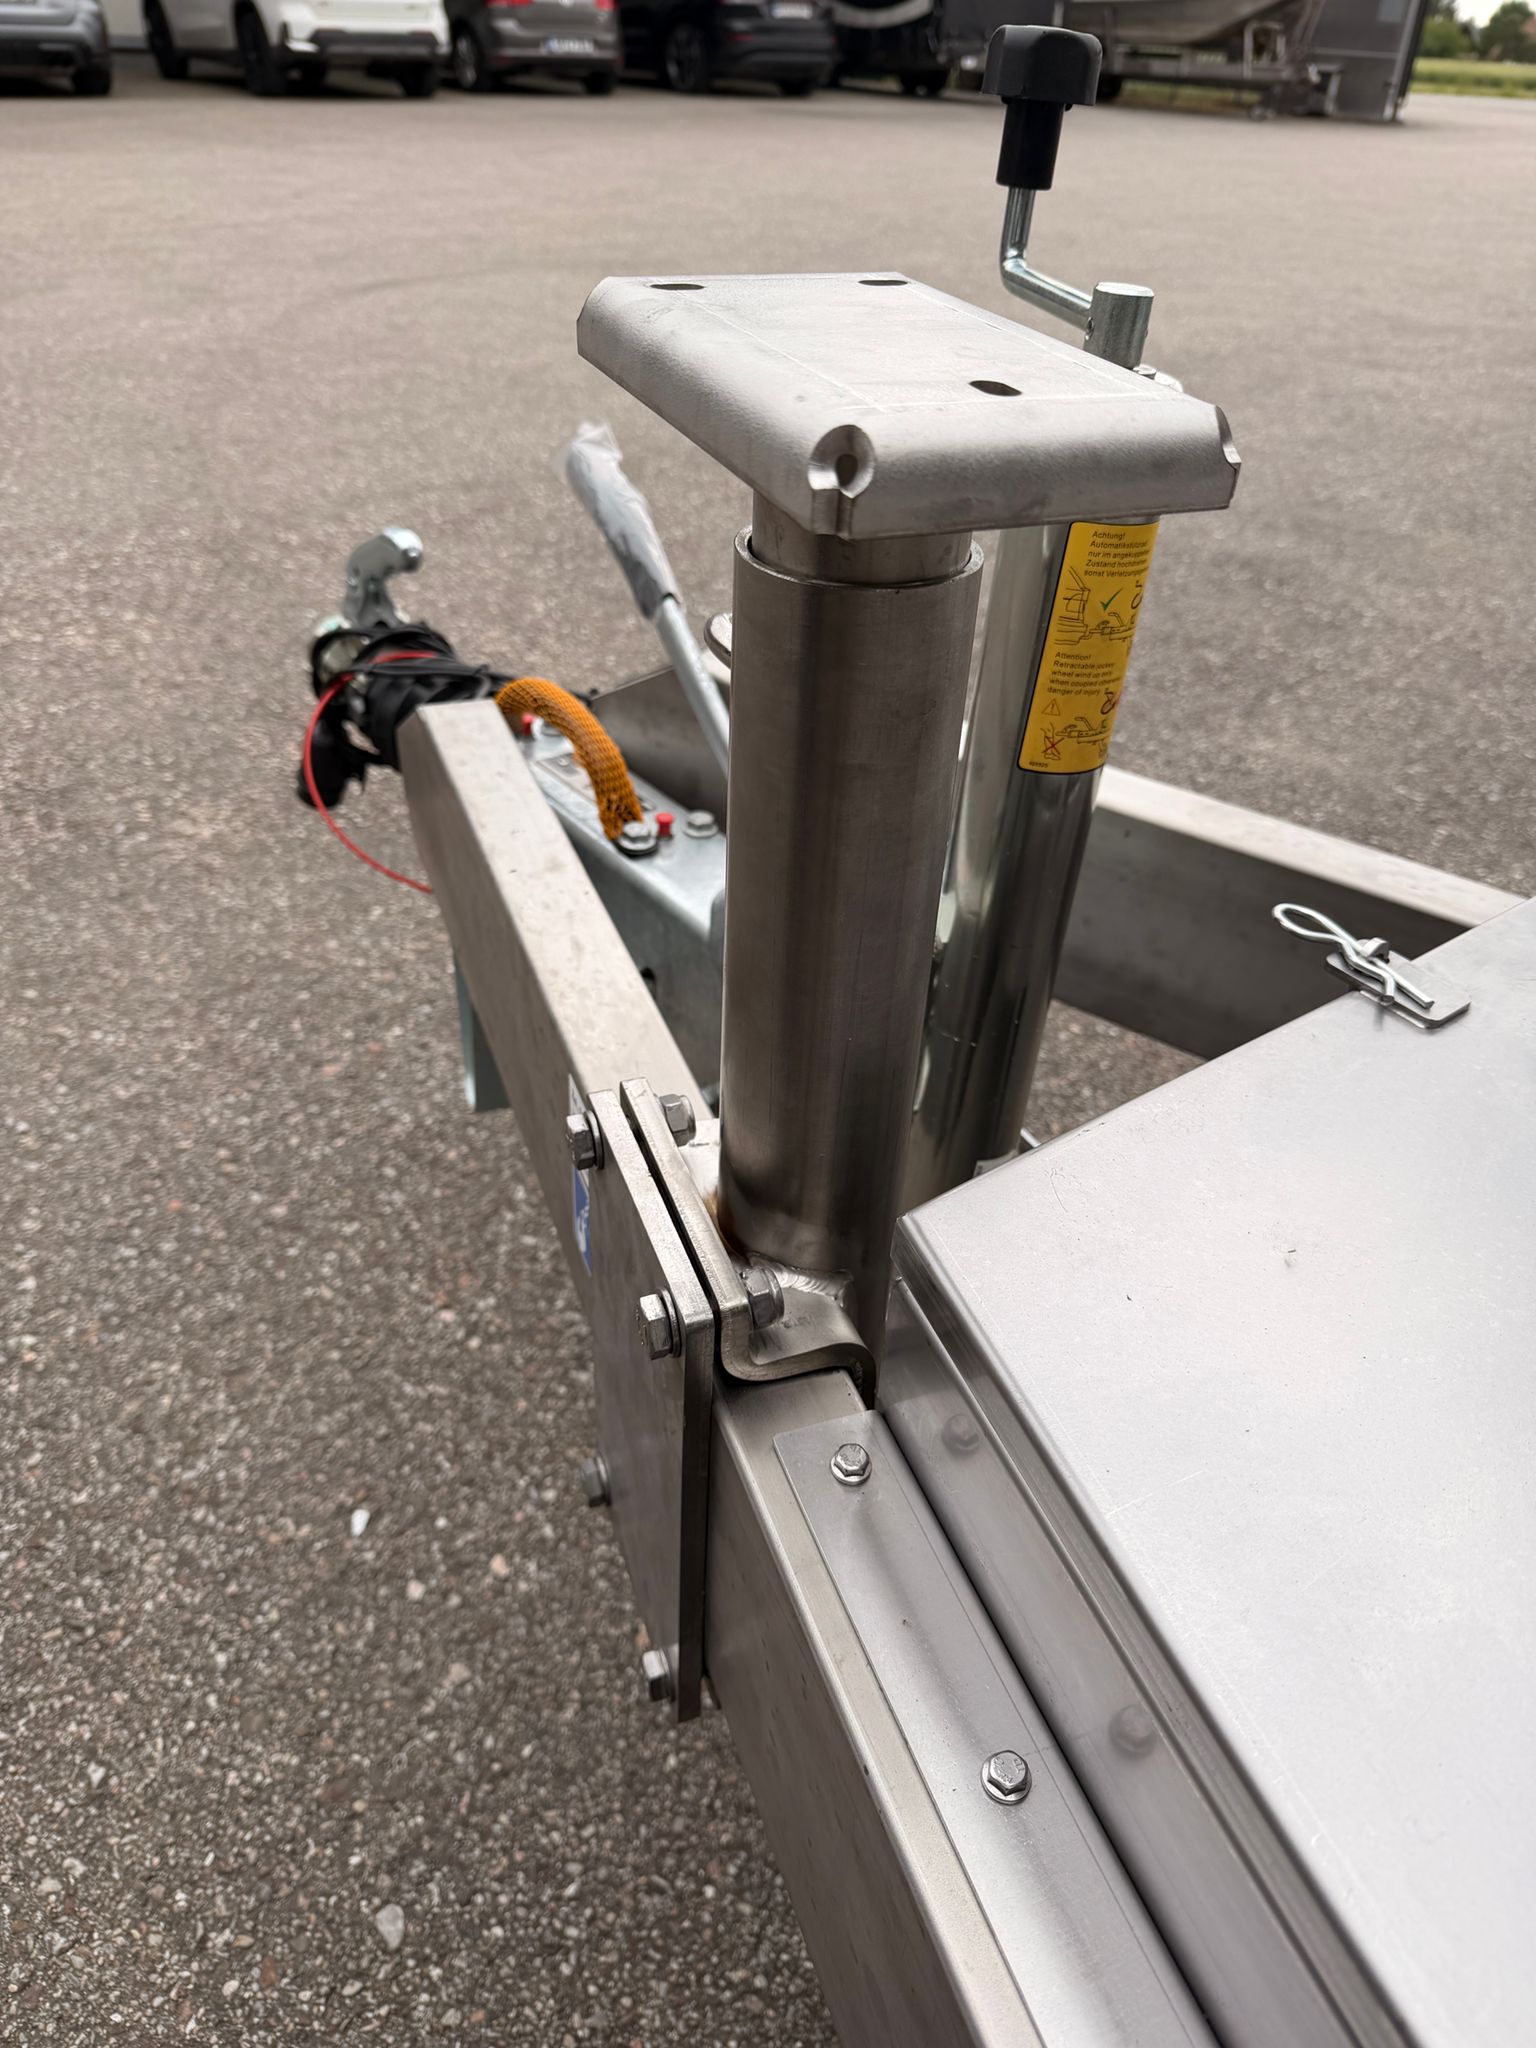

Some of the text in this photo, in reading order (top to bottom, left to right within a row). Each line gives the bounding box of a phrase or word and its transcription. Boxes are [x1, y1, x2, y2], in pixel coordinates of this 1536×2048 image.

[1092, 531, 1126, 541] Achtung!
[1086, 559, 1117, 568] Zustand
[1055, 651, 1092, 661] Attention!
[1053, 660, 1095, 670] Retractable
[1075, 671, 1092, 679] wind
[1049, 678, 1070, 686] when
[1070, 679, 1098, 688] coupled
[1047, 686, 1074, 696] danger
[1075, 688, 1083, 696] of
